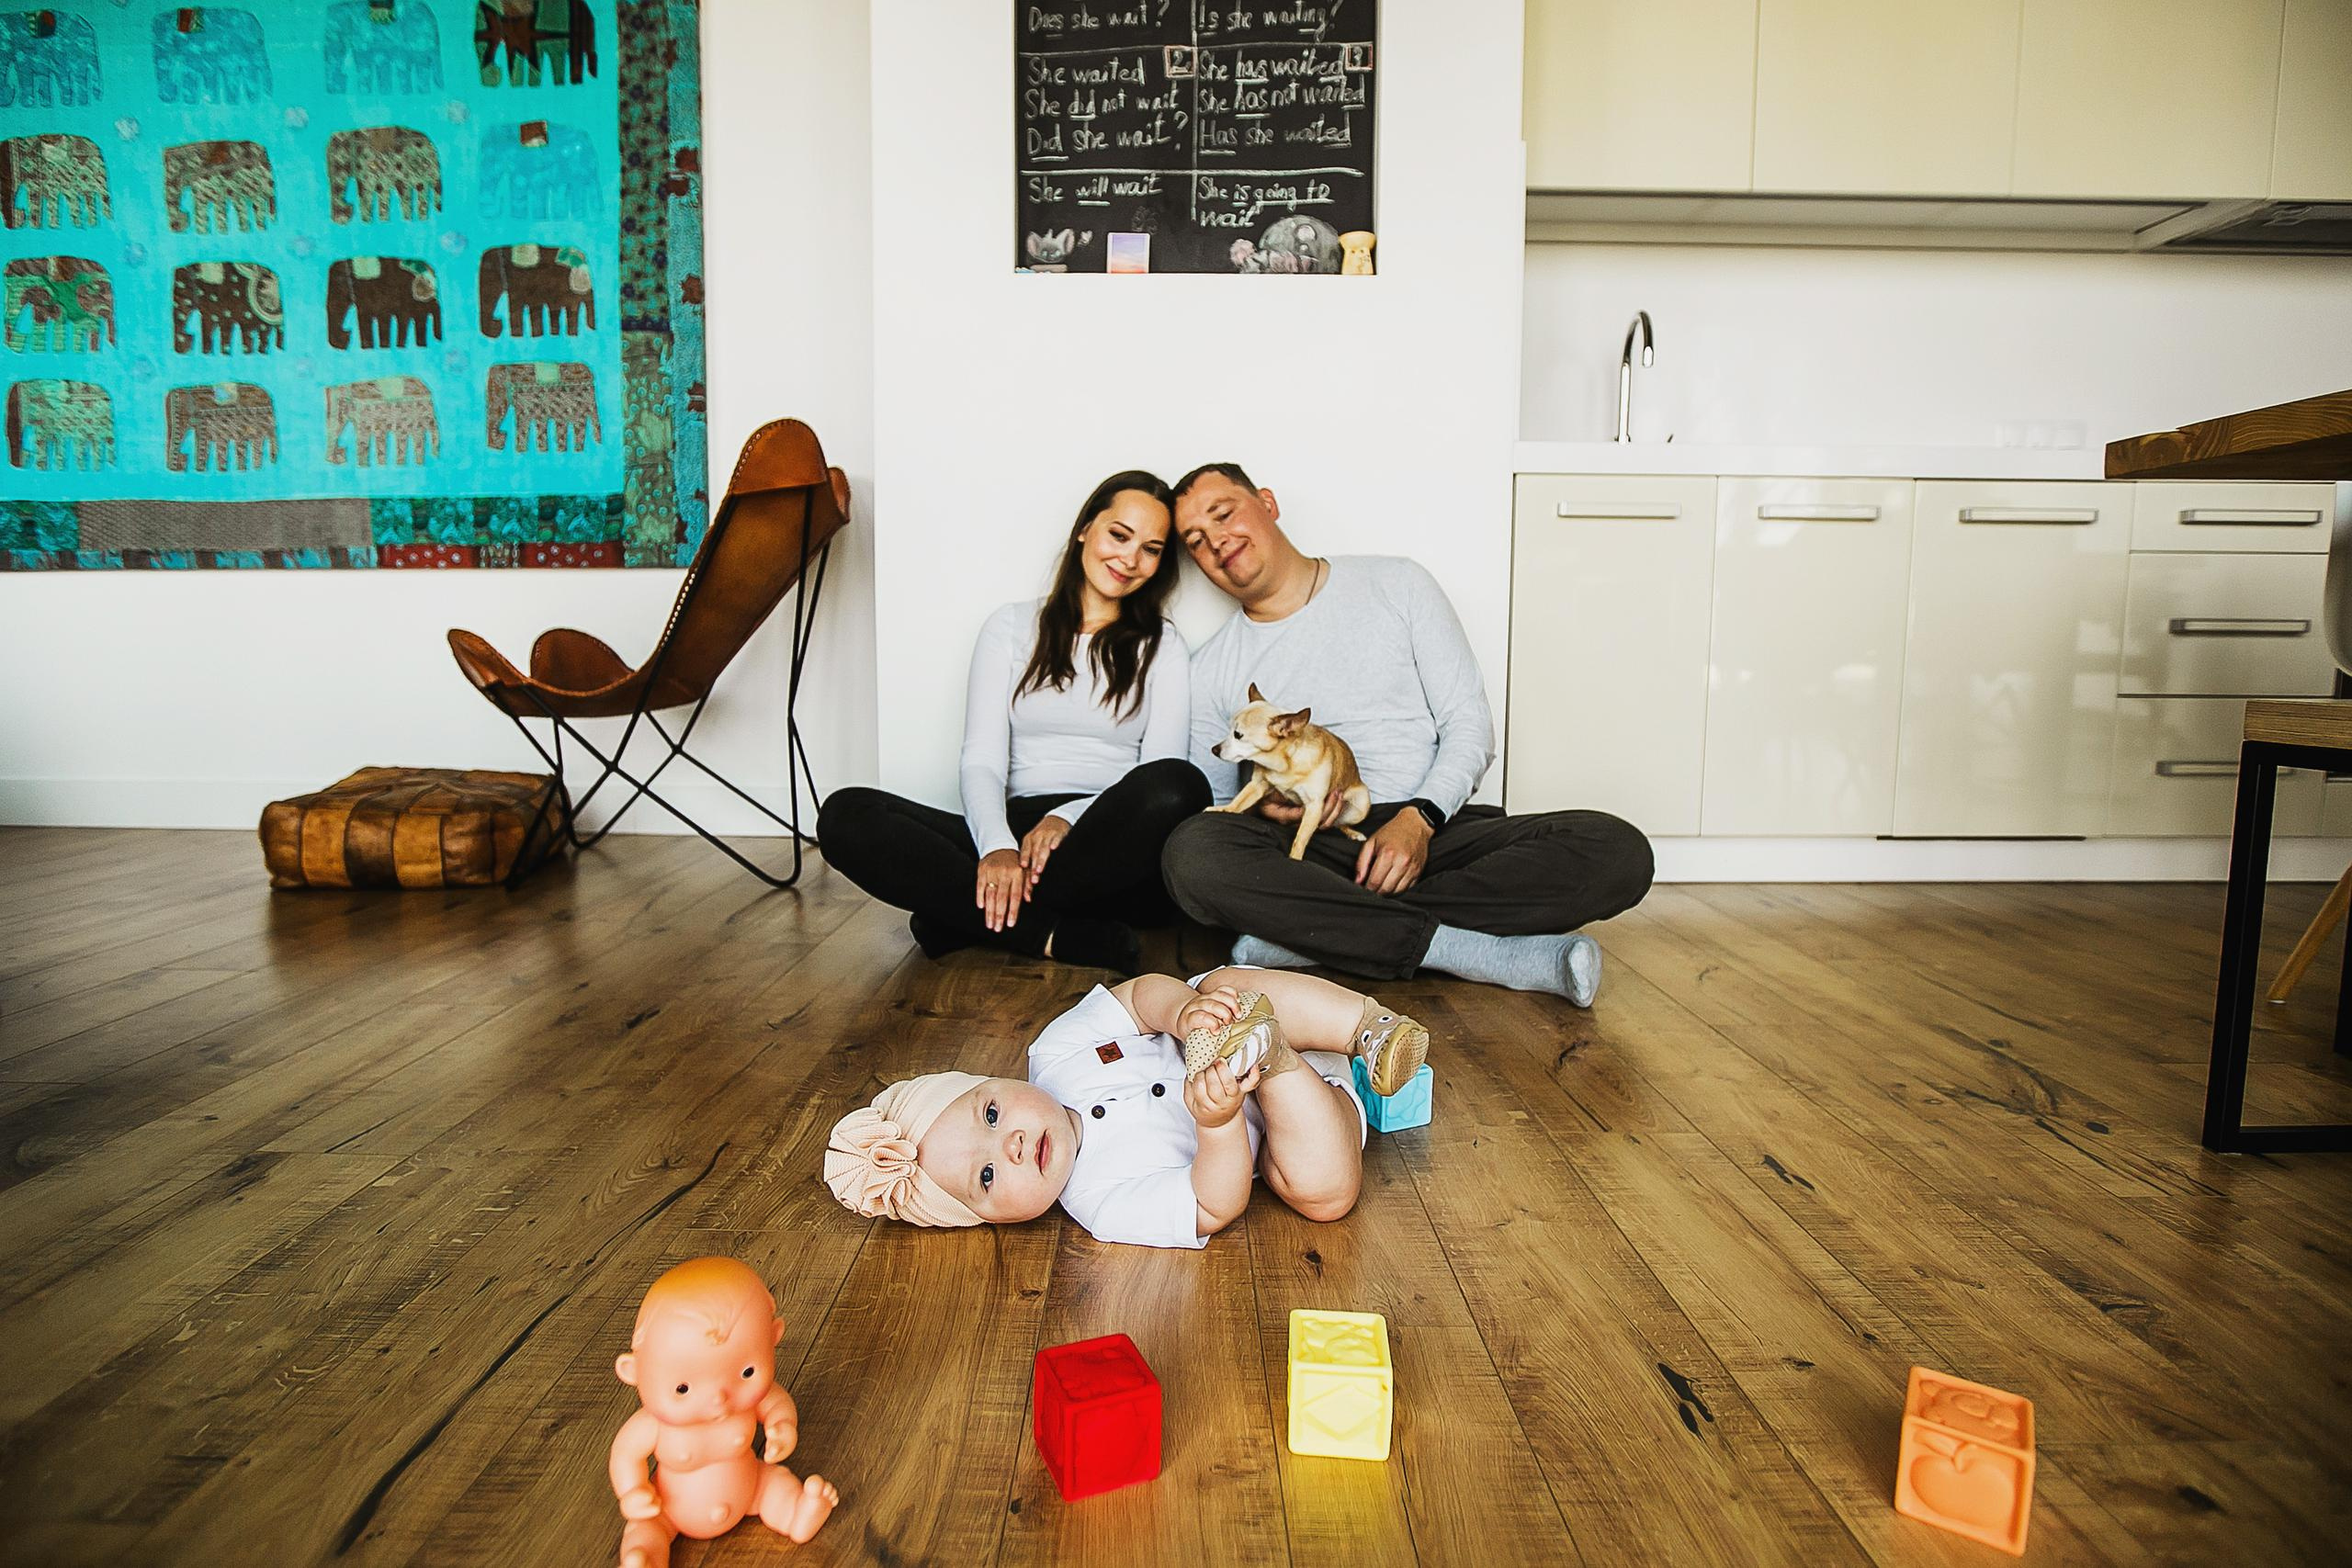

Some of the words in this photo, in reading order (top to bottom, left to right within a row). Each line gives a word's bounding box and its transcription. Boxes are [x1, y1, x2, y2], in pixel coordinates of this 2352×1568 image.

[1028, 6, 1065, 33] Does
[1071, 3, 1101, 29] she
[1027, 56, 1067, 86] She
[1071, 56, 1146, 87] waited
[1198, 49, 1229, 82] She
[1235, 49, 1268, 79] has
[1024, 87, 1061, 120] She
[1102, 87, 1127, 115] not
[1135, 79, 1180, 111] wait
[1198, 87, 1232, 115] She
[1234, 83, 1269, 113] has
[1270, 79, 1300, 108] not
[1027, 123, 1064, 156] Did
[1072, 121, 1110, 153] she
[1200, 118, 1239, 149] Has
[1245, 119, 1275, 147] she
[1029, 175, 1066, 205] She
[1075, 175, 1110, 198] will
[1113, 171, 1164, 197] wait
[1197, 175, 1229, 202] She
[1233, 184, 1252, 202] is
[1254, 183, 1297, 213] going
[1306, 178, 1331, 201] to
[1199, 203, 1257, 229] wait
